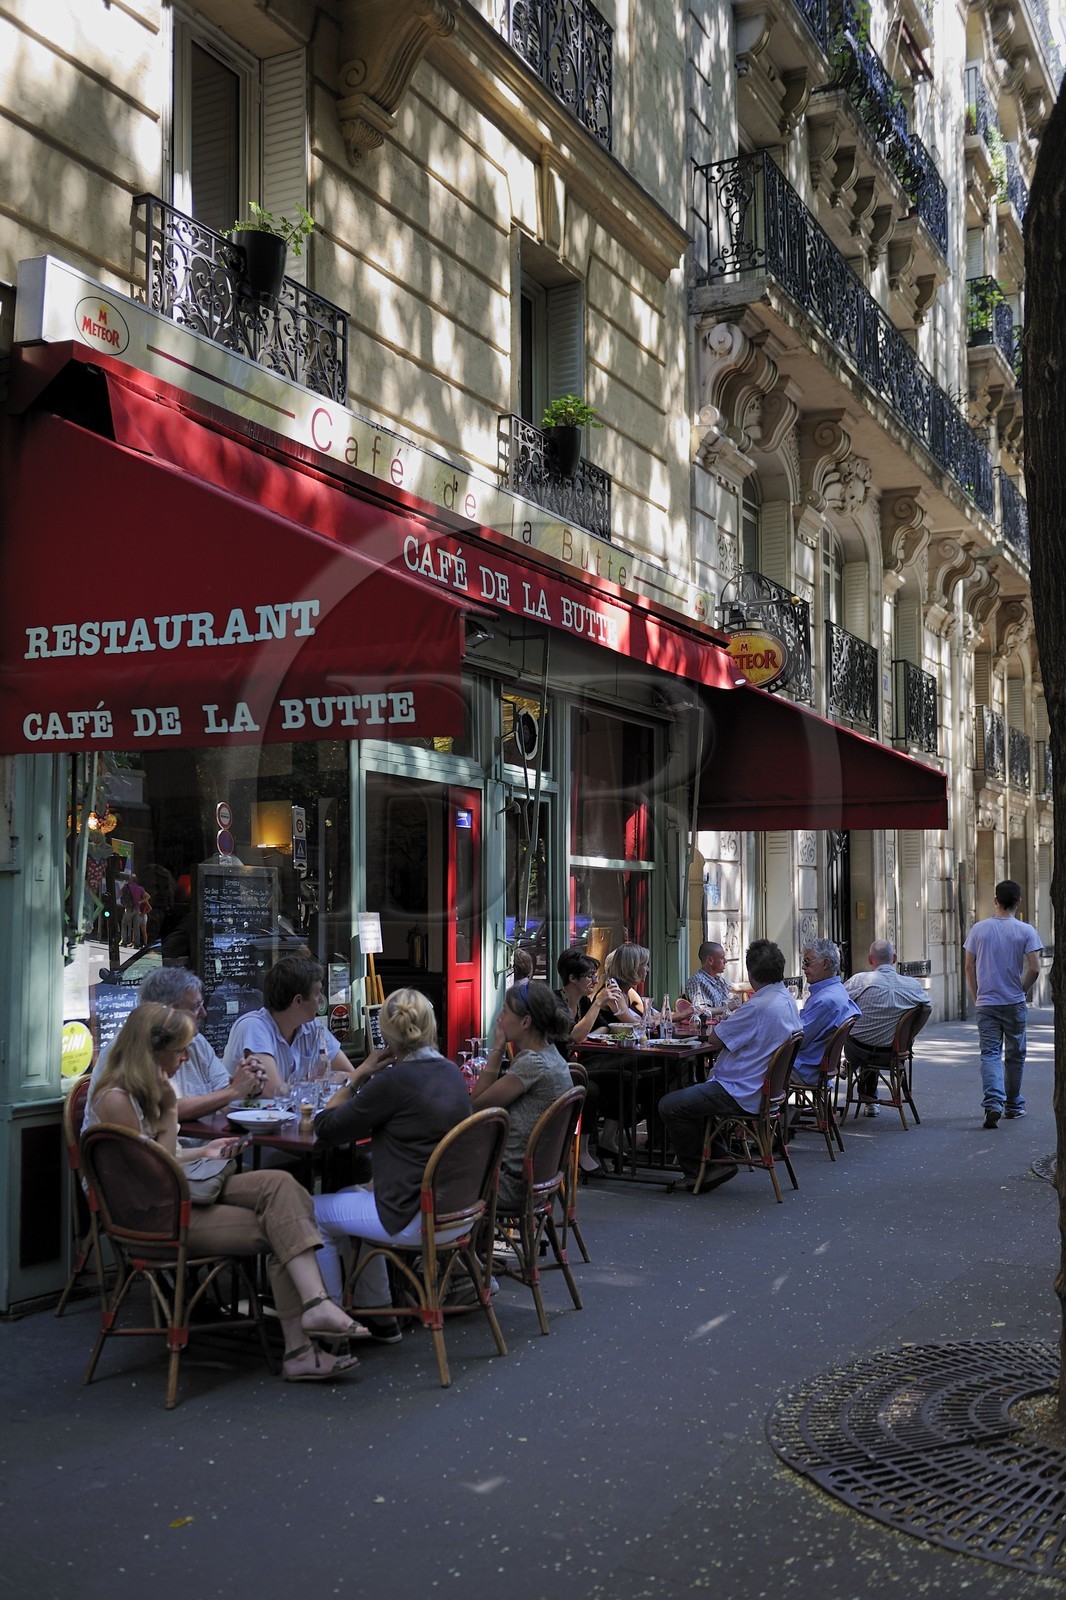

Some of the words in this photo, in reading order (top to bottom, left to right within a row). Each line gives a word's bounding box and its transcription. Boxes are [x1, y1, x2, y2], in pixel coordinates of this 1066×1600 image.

[81, 315, 120, 349] METEOR
[311, 408, 404, 486] Café
[443, 475, 476, 519] de
[511, 503, 532, 545] la
[562, 529, 627, 587] Butte
[403, 535, 469, 591] CAFÉ
[479, 565, 510, 606] DE
[522, 581, 551, 621] LA
[560, 596, 617, 648] BUTTE
[24, 599, 320, 660] RESTAURANT
[22, 700, 114, 742] CAFÉ
[131, 706, 182, 737] DE
[202, 702, 260, 734] LA
[279, 691, 416, 730] BUTTE
